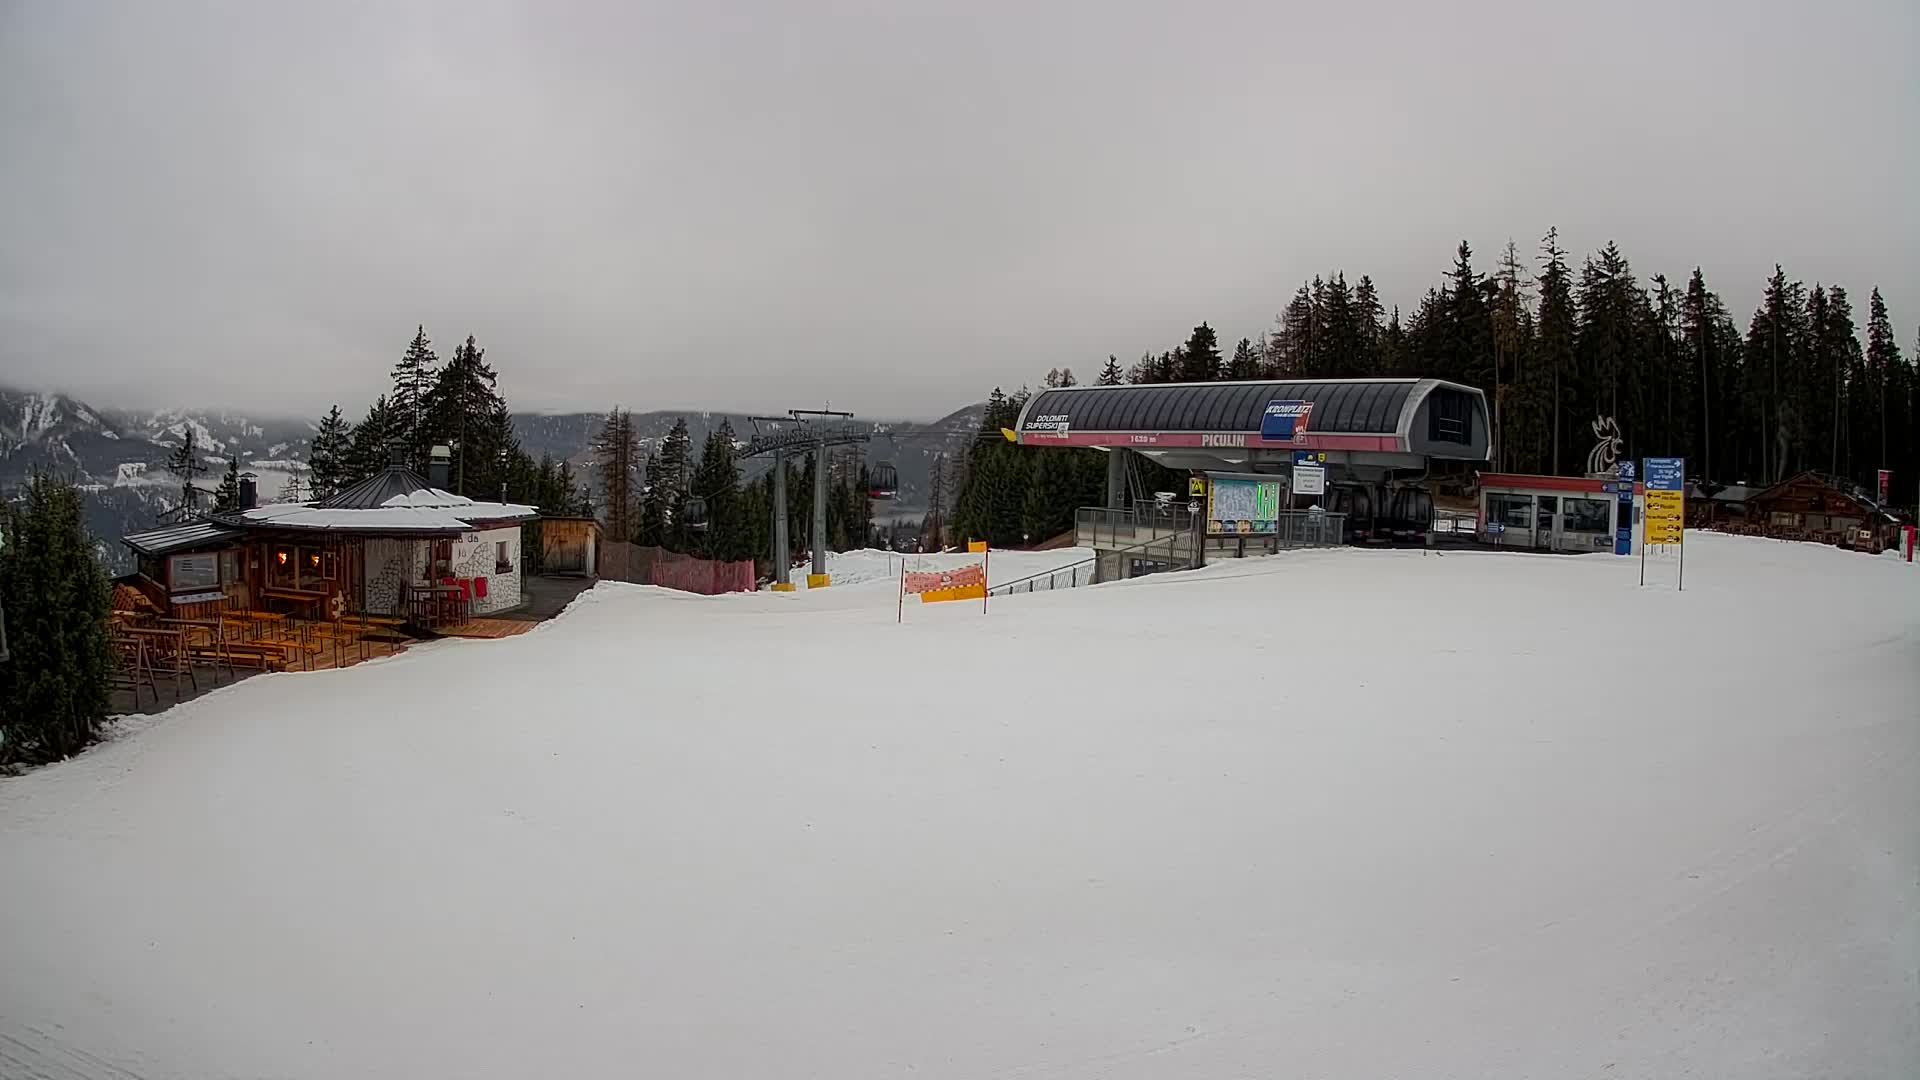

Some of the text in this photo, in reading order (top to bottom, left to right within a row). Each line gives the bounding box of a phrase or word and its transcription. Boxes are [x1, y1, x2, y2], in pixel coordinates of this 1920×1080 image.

[1265, 405, 1310, 414] KRONPLATZ
[1025, 422, 1059, 430] SUPERSKI
[1201, 434, 1245, 447] PICULIN
[467, 533, 479, 543] da
